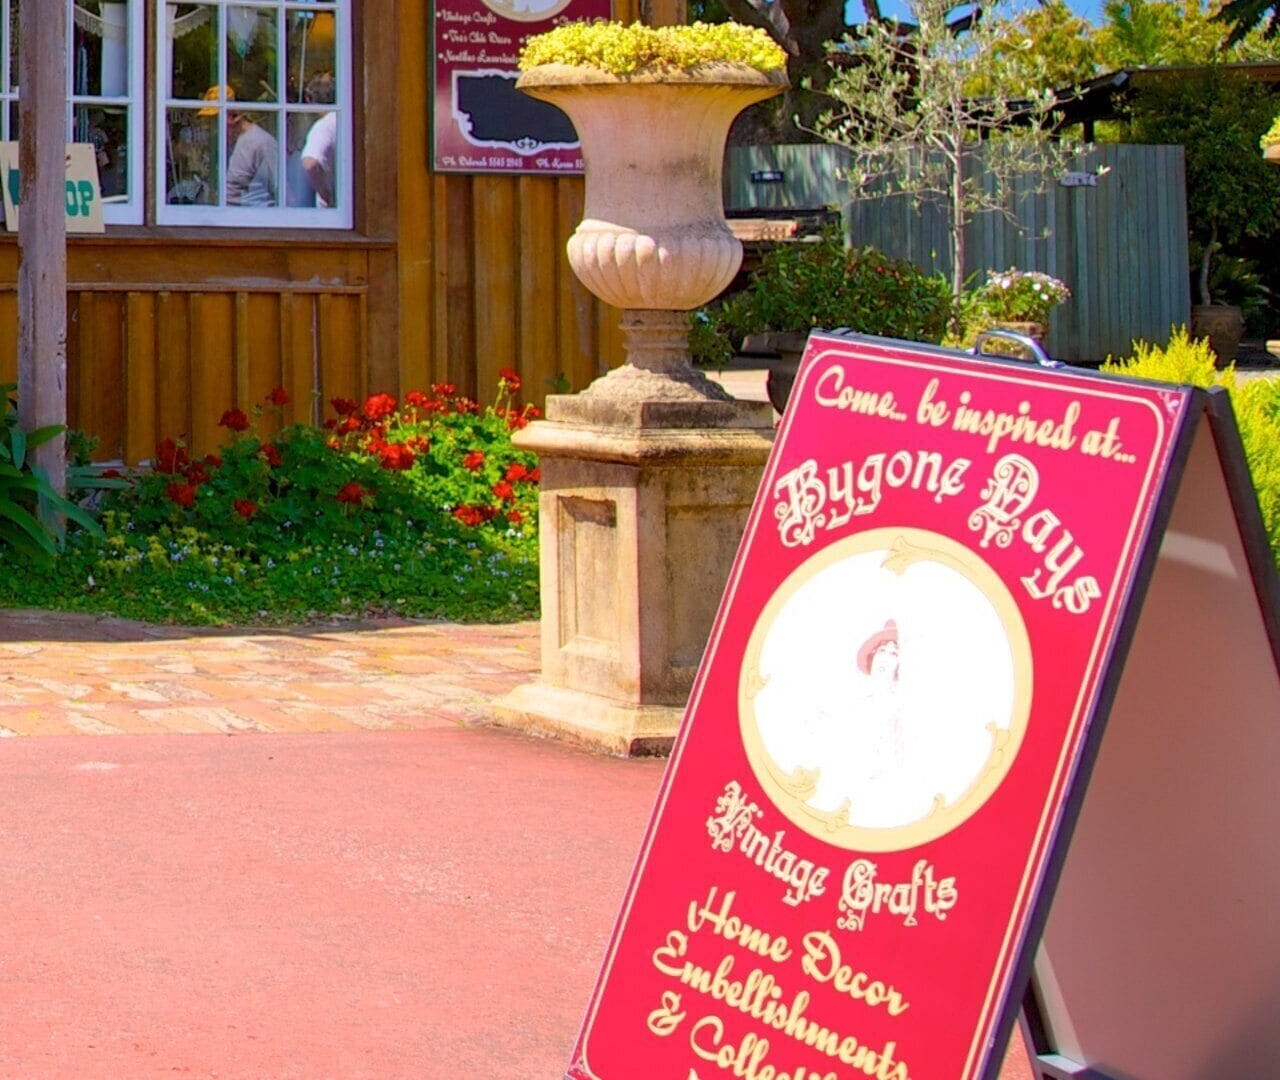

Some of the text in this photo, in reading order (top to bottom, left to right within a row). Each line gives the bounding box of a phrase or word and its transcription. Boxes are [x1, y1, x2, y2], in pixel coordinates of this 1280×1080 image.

[65, 180, 94, 216] OP
[917, 377, 951, 427] be
[951, 391, 1081, 454] inspired
[773, 450, 1102, 614] Bygone Days
[706, 780, 958, 932] Vintage Crafts
[646, 990, 687, 1037] &
[652, 929, 912, 1080] Embellishments
[687, 886, 910, 1017] Home Decor
